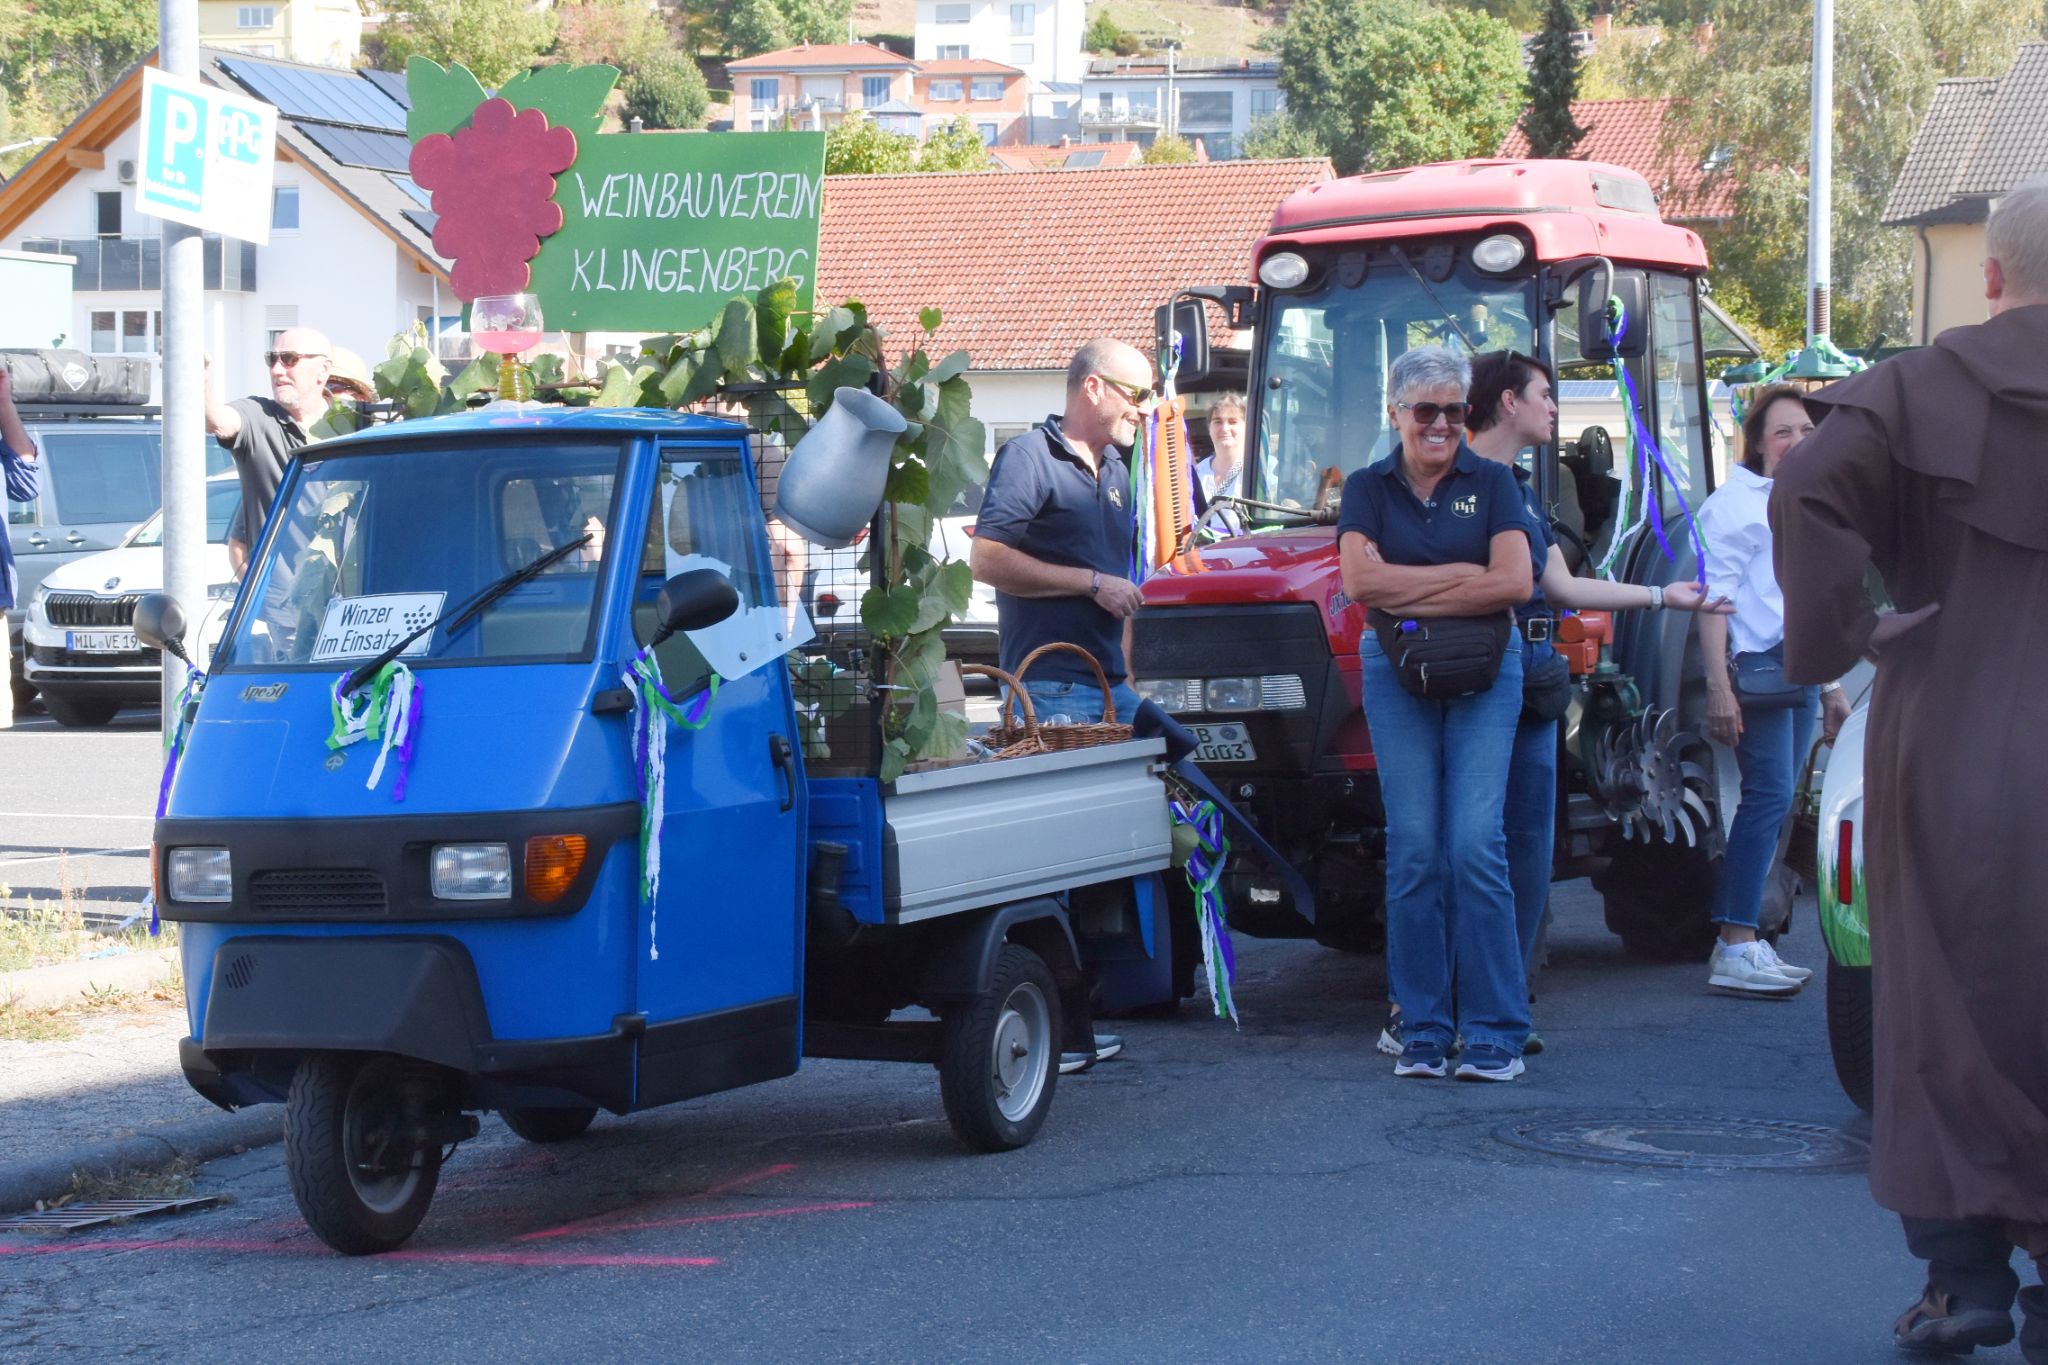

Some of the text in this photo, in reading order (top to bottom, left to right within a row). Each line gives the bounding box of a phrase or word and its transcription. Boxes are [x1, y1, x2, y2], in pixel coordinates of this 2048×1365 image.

[163, 94, 198, 166] P
[218, 110, 262, 157] PPG
[575, 171, 823, 219] WEINBAUVEREIN
[570, 246, 809, 293] KLINGENBERG
[340, 603, 394, 627] Winzer
[74, 634, 97, 649] MIL
[104, 634, 120, 649] VE
[318, 628, 400, 655] im Einsatz
